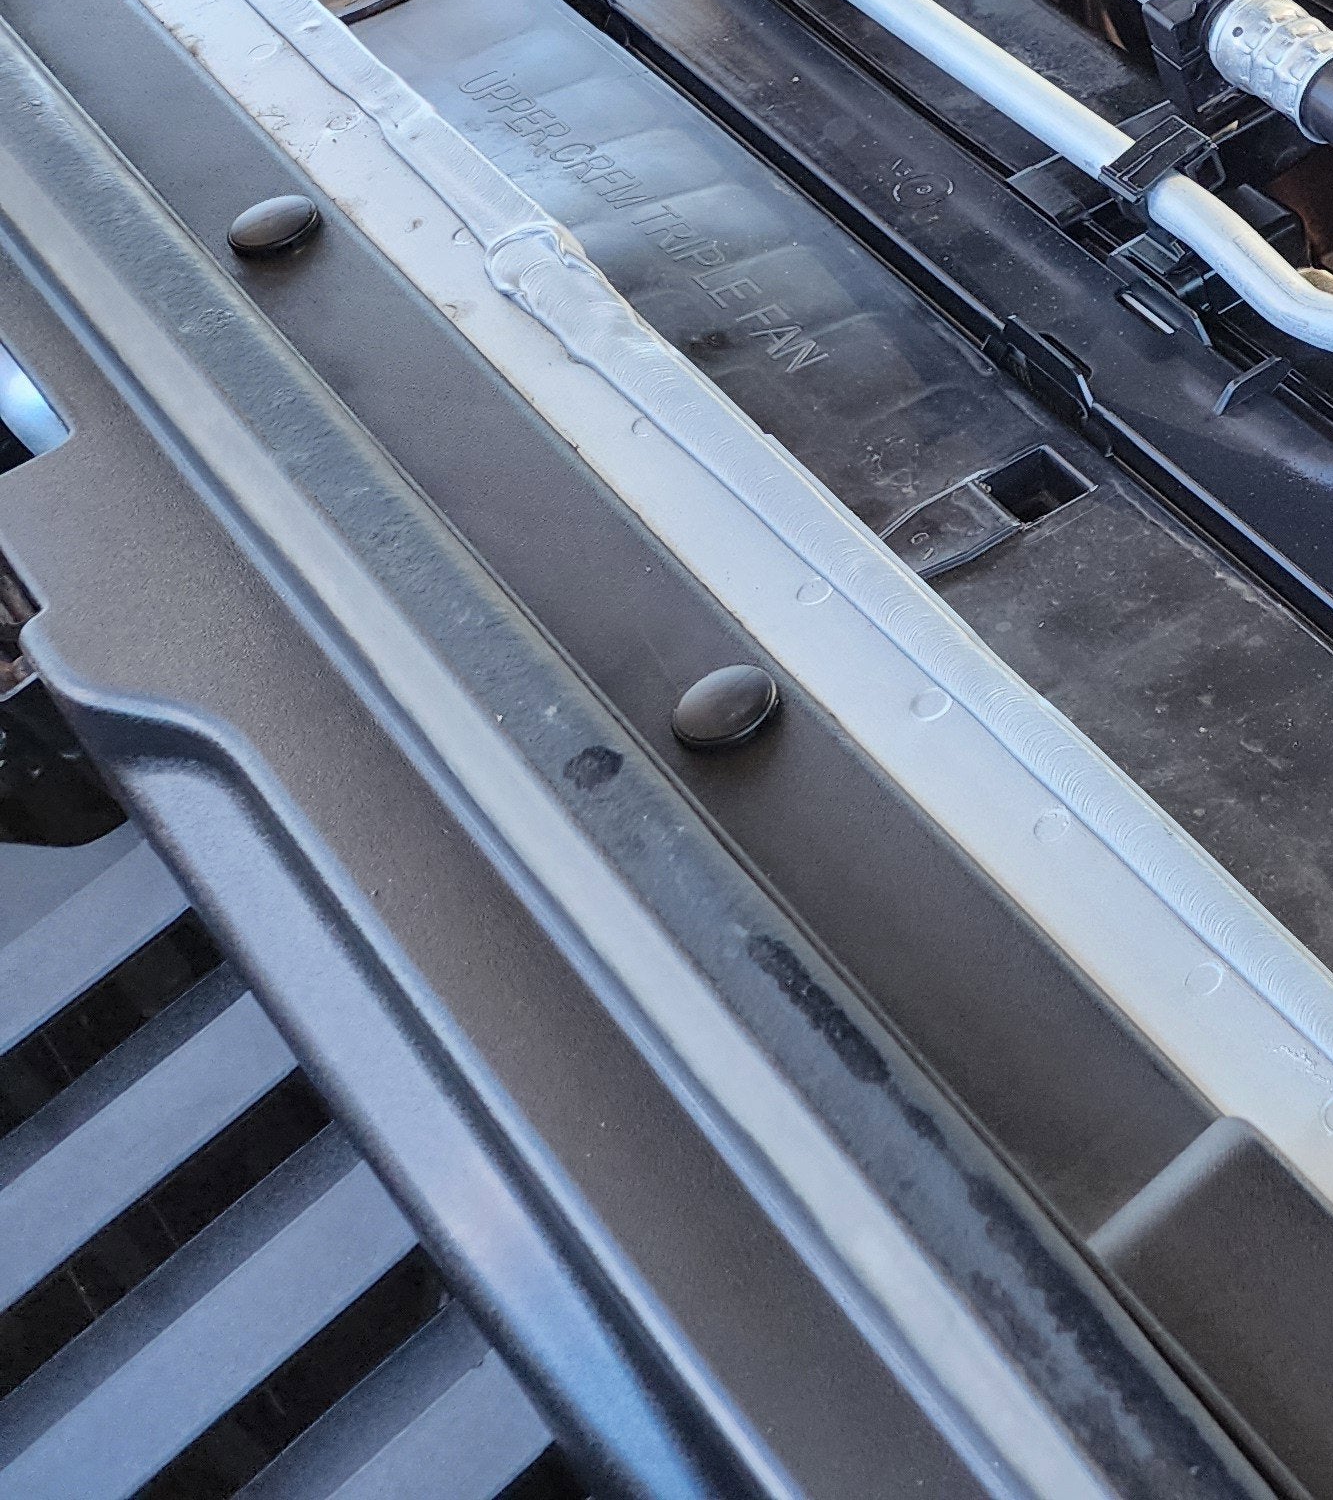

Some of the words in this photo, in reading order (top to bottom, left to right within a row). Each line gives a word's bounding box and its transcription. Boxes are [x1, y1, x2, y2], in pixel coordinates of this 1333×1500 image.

[457, 70, 572, 148] UPPER
[548, 142, 656, 211] CRFM
[631, 204, 764, 311] TRIPLE
[734, 303, 830, 375] FAN
